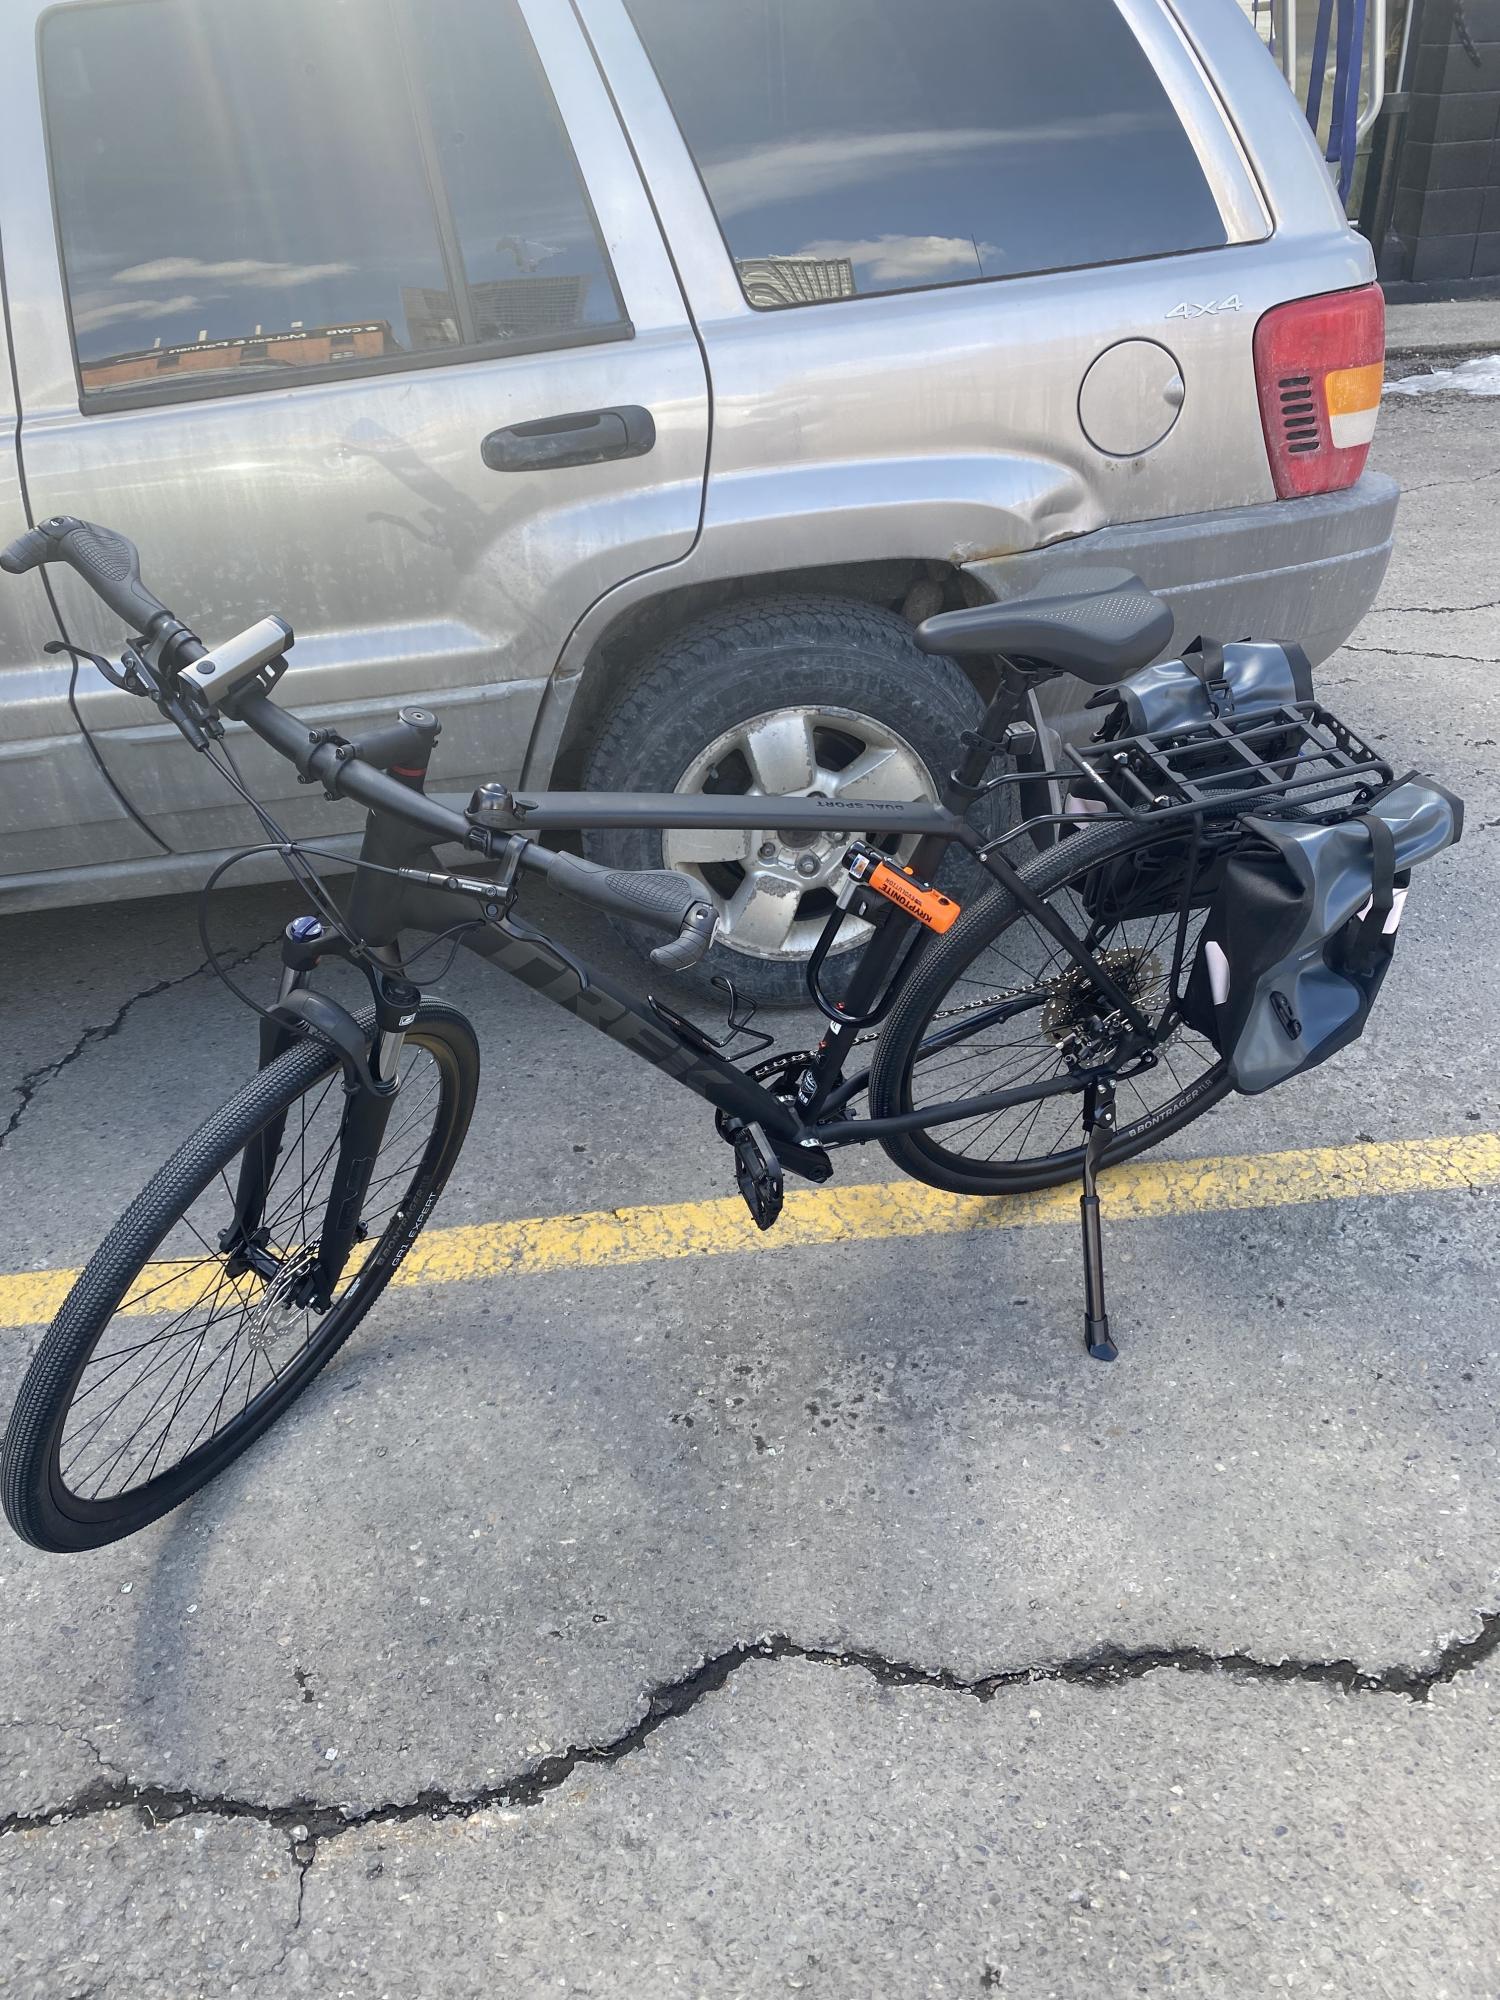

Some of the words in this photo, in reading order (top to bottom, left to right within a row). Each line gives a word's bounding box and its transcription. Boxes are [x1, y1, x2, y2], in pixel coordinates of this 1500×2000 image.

[816, 801, 865, 809] SPORT
[867, 803, 904, 811] DUAL
[880, 883, 932, 923] KRYPTONITE
[885, 878, 916, 904] EVOLUTION
[484, 921, 734, 1102] TREK
[1137, 1090, 1199, 1134] BONTRAGER
[1198, 1079, 1213, 1092] TLR
[391, 1244, 409, 1267] GR1
[408, 1191, 437, 1238] EXPERT
